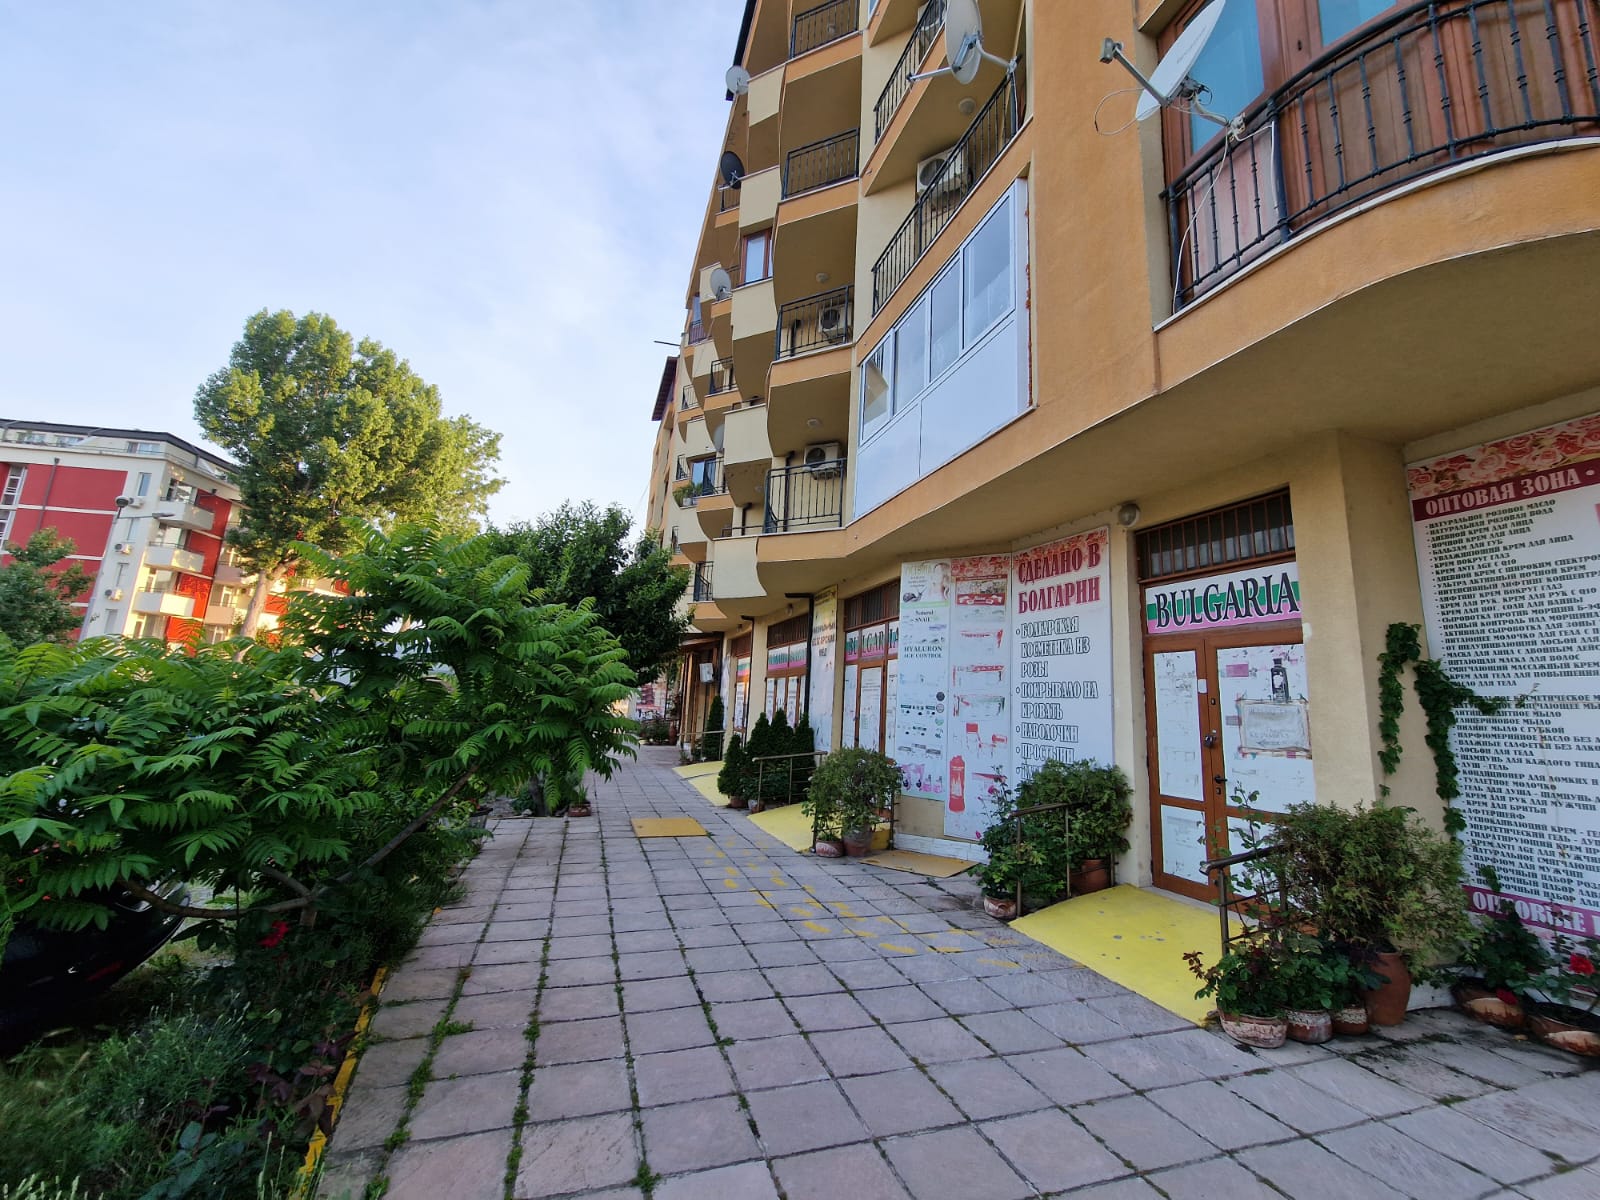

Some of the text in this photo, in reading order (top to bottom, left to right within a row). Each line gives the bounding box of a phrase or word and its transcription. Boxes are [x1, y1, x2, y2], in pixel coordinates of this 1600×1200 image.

[1425, 469, 1580, 515] ОПТОВАЯ ЗОНА
[1528, 500, 1555, 510] МАСЛО
[1466, 534, 1486, 543] КРЕМ
[1490, 531, 1505, 539] ДЛЯ
[1469, 527, 1489, 535] КРЕМ
[1503, 542, 1525, 551] КРЕМ
[1529, 539, 1545, 547] ДЛЯ
[1018, 542, 1101, 586] СДЕЛАНО В
[1434, 560, 1454, 568] КРЕМ
[1436, 567, 1455, 575] КРЕМ
[1560, 565, 1586, 573] КРЕМ
[1475, 569, 1495, 577] КРЕМ
[1018, 576, 1101, 613] БОЛГАРИИ
[1155, 572, 1299, 628] BULGARIA
[1479, 590, 1500, 598] КРЕМ
[1021, 616, 1079, 638] БОЛГАРСКАЯ
[1021, 636, 1090, 658] КОСМЕТИКА ИЗ
[1021, 661, 1048, 678] РОЗЫ
[1021, 681, 1099, 698] ПОКРЫВАЛО НА
[1021, 702, 1063, 720] КРОВАТЬ
[1021, 723, 1079, 743] НАВОЛОЧКИ
[1021, 743, 1074, 765] ПРОСТЫНИ
[1466, 792, 1486, 800] КРЕМ
[1551, 826, 1576, 834] КРЕМ
